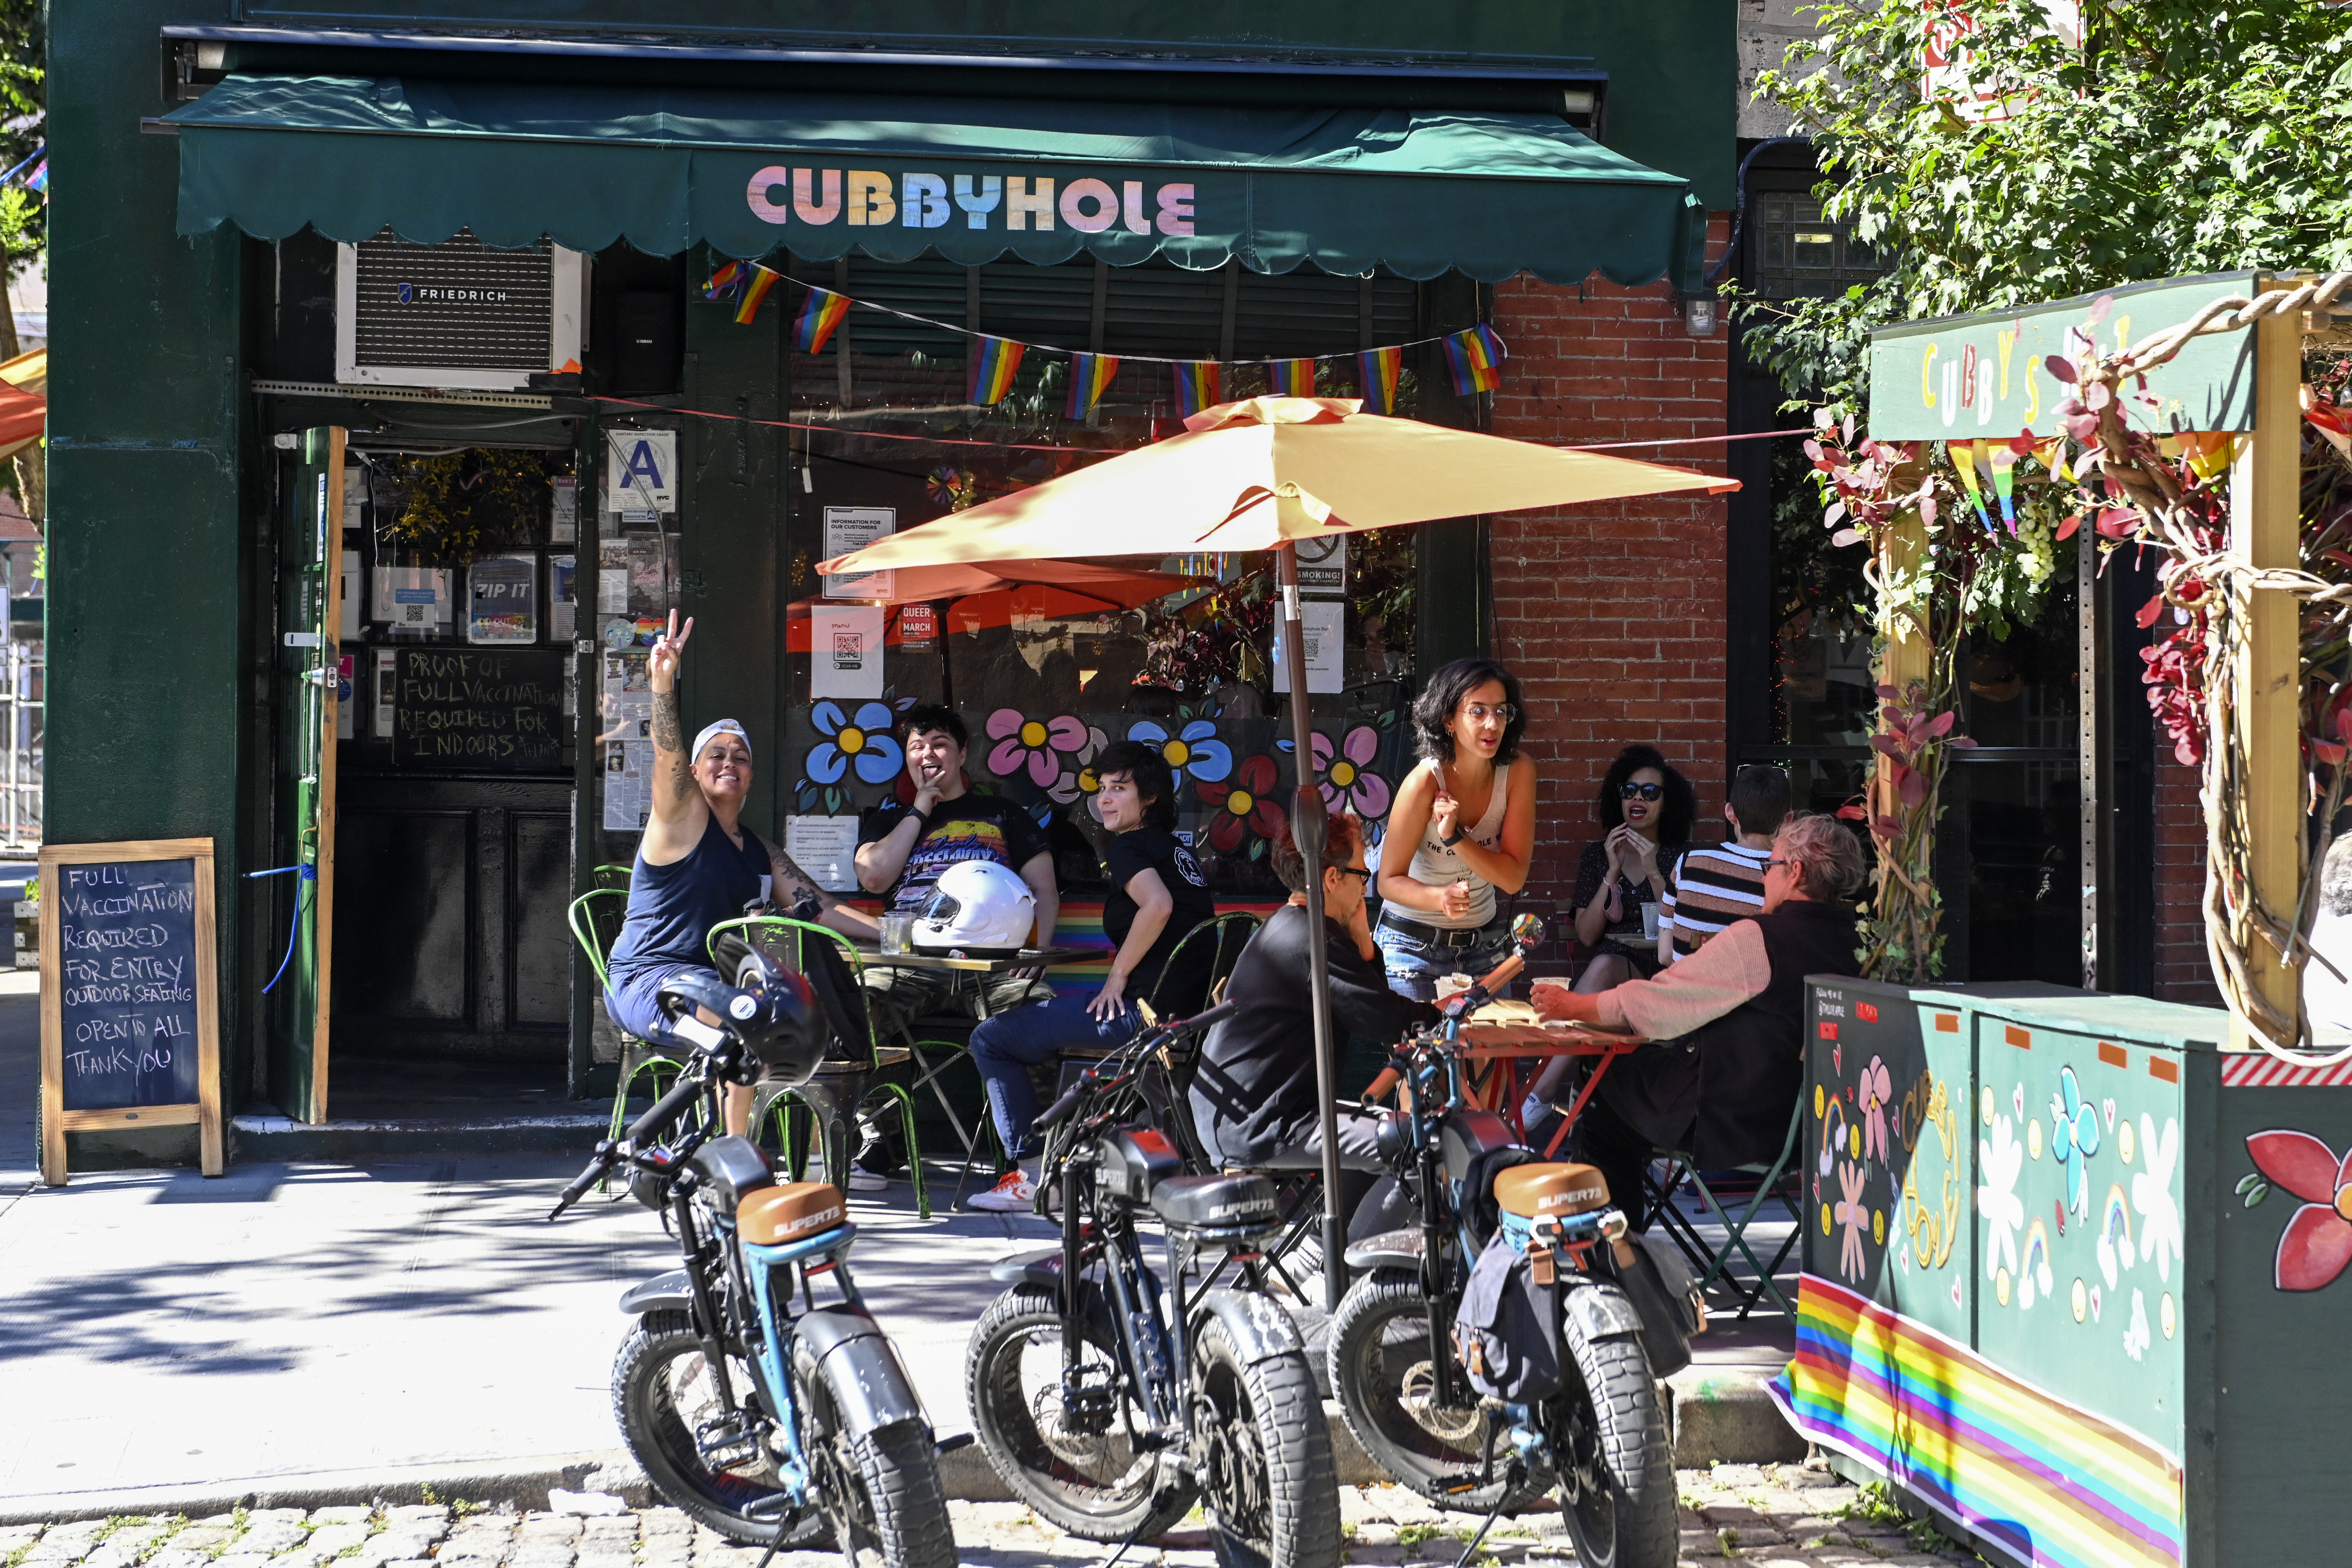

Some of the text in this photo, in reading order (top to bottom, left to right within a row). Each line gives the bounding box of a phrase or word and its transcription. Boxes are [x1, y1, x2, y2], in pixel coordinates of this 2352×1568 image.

[747, 165, 1195, 237] CUBBYHOLE
[420, 289, 506, 301] FRIEDRICH
[619, 440, 664, 489] A
[1297, 571, 1340, 579] SMOKING!
[477, 583, 530, 598] ZIP IT
[903, 607, 930, 617] QUEER
[903, 623, 930, 631] MARCH
[409, 652, 513, 679] PROOF OF
[401, 678, 563, 708] FULL VACCINATION
[399, 709, 511, 733] REQUIRED
[513, 706, 548, 734] FOR
[409, 732, 515, 761] INDOORS
[1427, 841, 1442, 853] THE
[69, 867, 124, 888] FULL
[62, 883, 193, 917] VACCINATION
[64, 924, 168, 952] REQUIRED
[65, 956, 183, 994] FOR ENTRY
[65, 982, 191, 1006] OUTDOOR SEATING
[76, 1014, 191, 1043] OPEN TO ALL
[66, 1046, 171, 1087] THANK YOU
[1209, 1198, 1274, 1220] SUPER73
[1538, 1186, 1602, 1210] SUPER73
[773, 1205, 841, 1238] SUPER73
